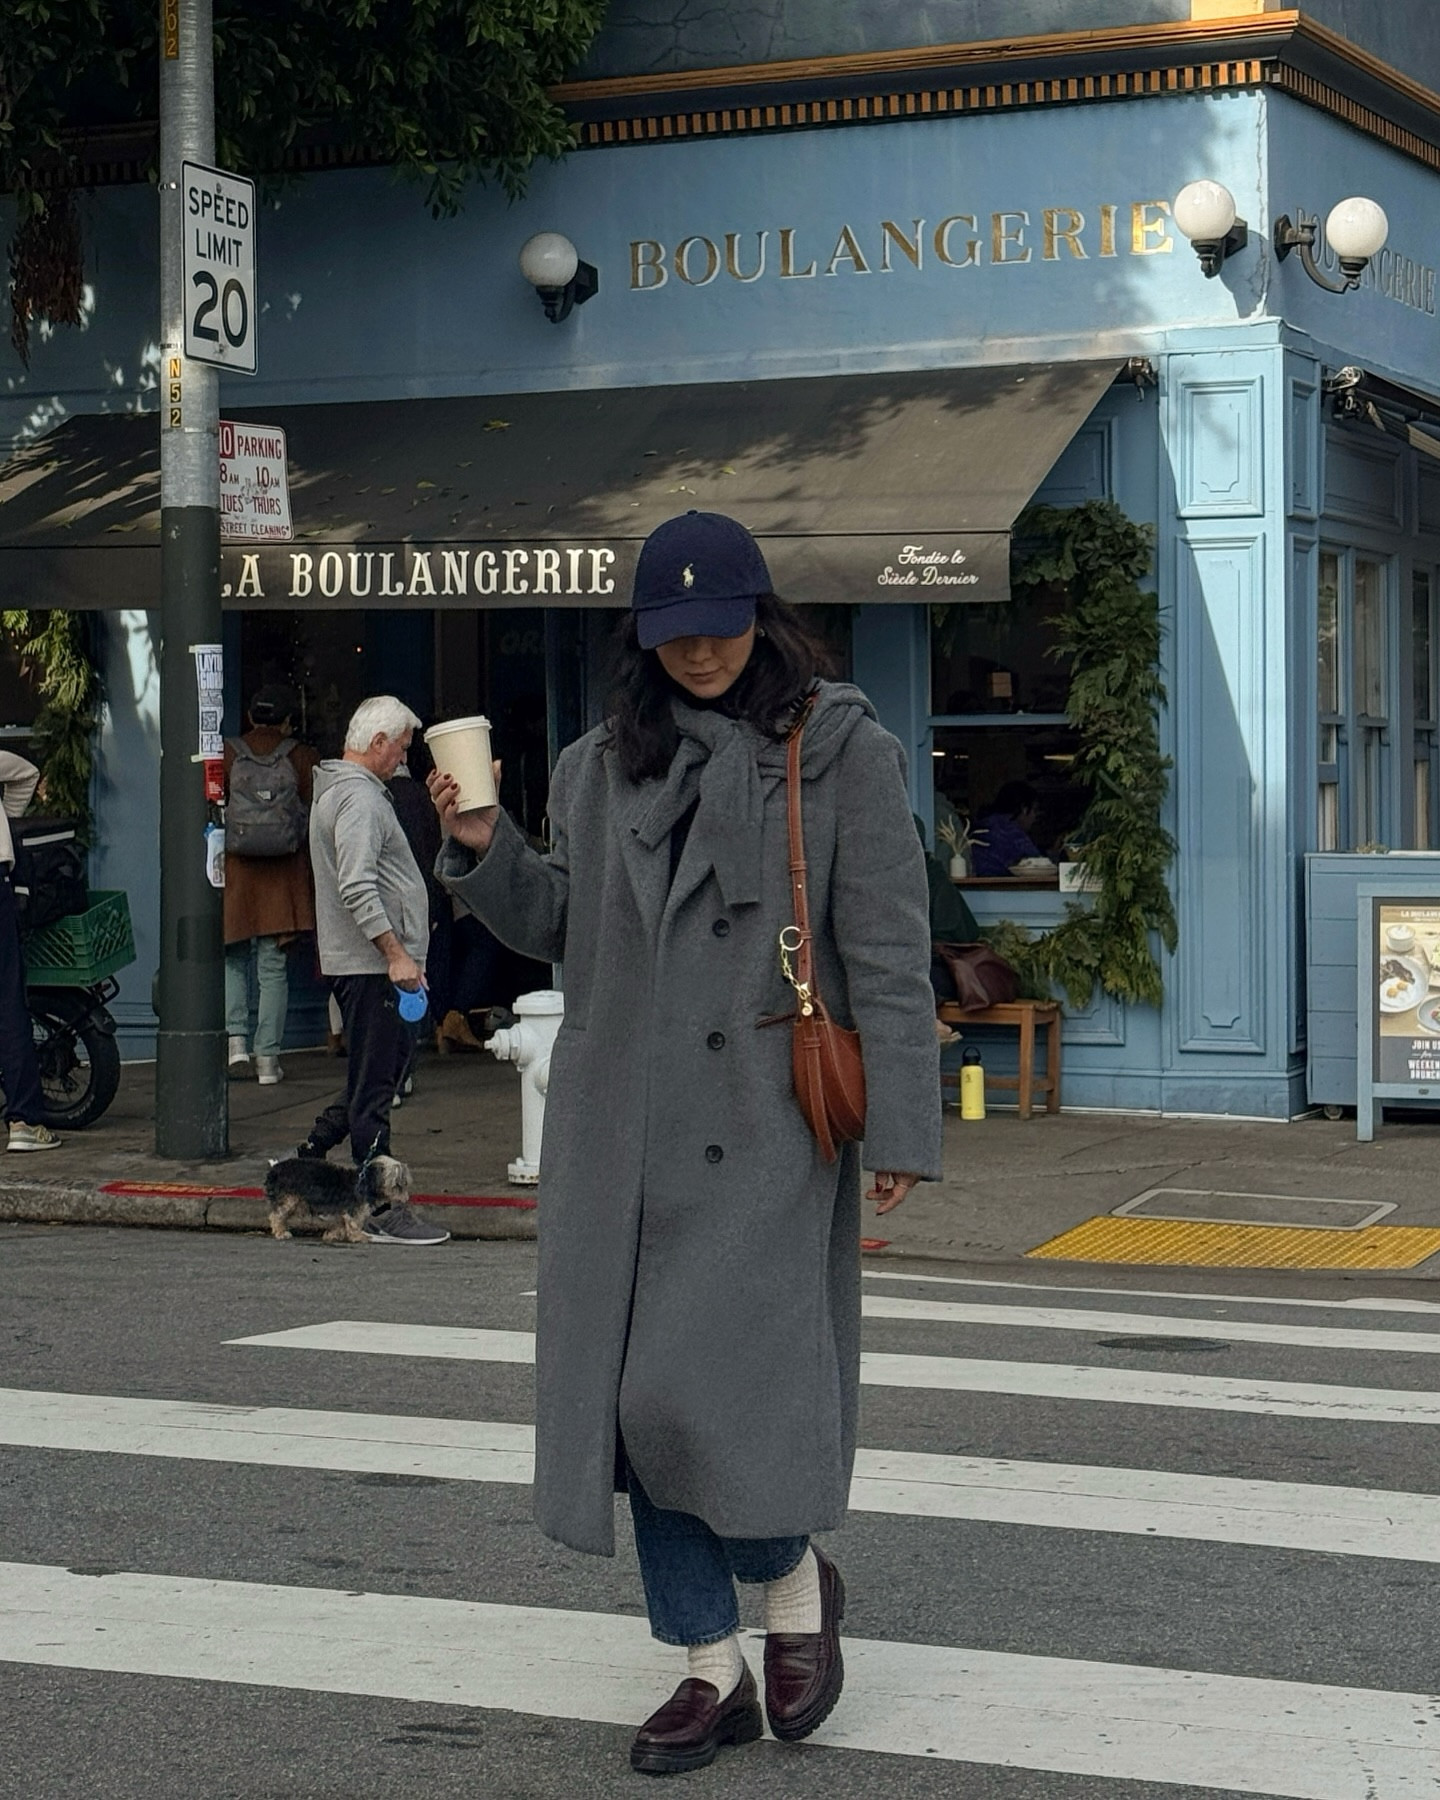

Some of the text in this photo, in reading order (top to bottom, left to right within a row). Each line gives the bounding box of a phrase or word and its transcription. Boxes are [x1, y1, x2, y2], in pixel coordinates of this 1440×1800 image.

[189, 187, 249, 229] SPEED
[196, 227, 243, 267] LIMIT
[629, 200, 1174, 291] BOULANGERIE
[192, 270, 248, 348] 20
[170, 359, 181, 427] N52
[237, 435, 282, 460] PARKING
[221, 493, 282, 516] TUES THURS
[221, 522, 247, 534] STREET
[898, 545, 966, 565] Fondée le
[288, 548, 616, 598] BOULANGERIE
[877, 566, 980, 586] Siècle Dernier
[1411, 1039, 1430, 1051] JOIN
